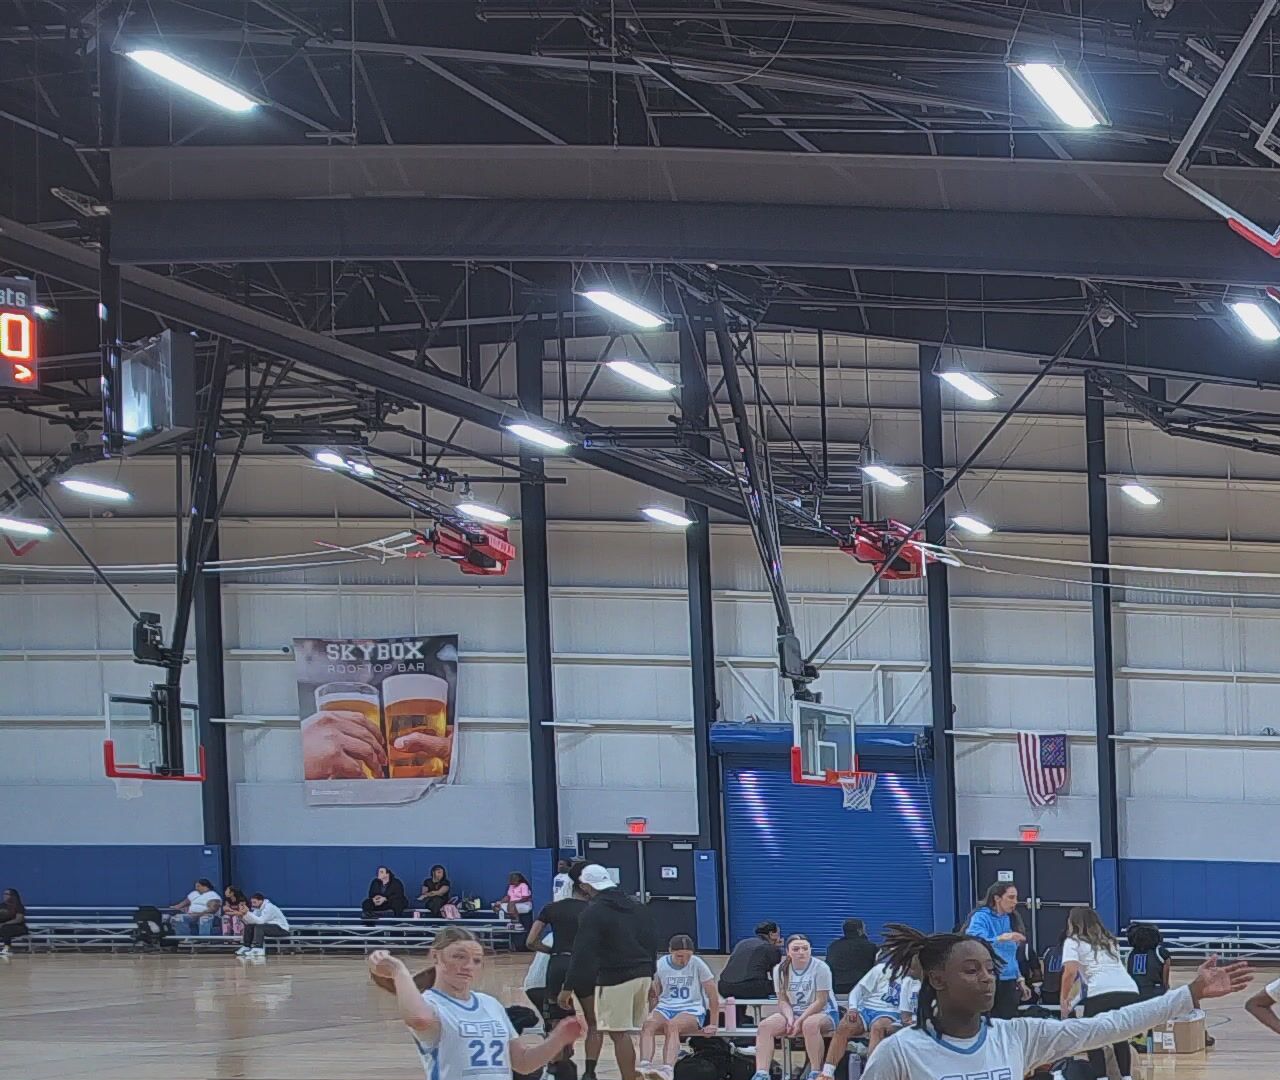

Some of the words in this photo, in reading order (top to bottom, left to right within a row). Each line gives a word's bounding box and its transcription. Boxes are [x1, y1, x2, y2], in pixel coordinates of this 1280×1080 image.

[326, 641, 425, 661] SKYBOX
[327, 663, 393, 674] ROOFTOP
[397, 662, 425, 673] BAR
[669, 986, 690, 1000] 30
[468, 1039, 504, 1067] 22
